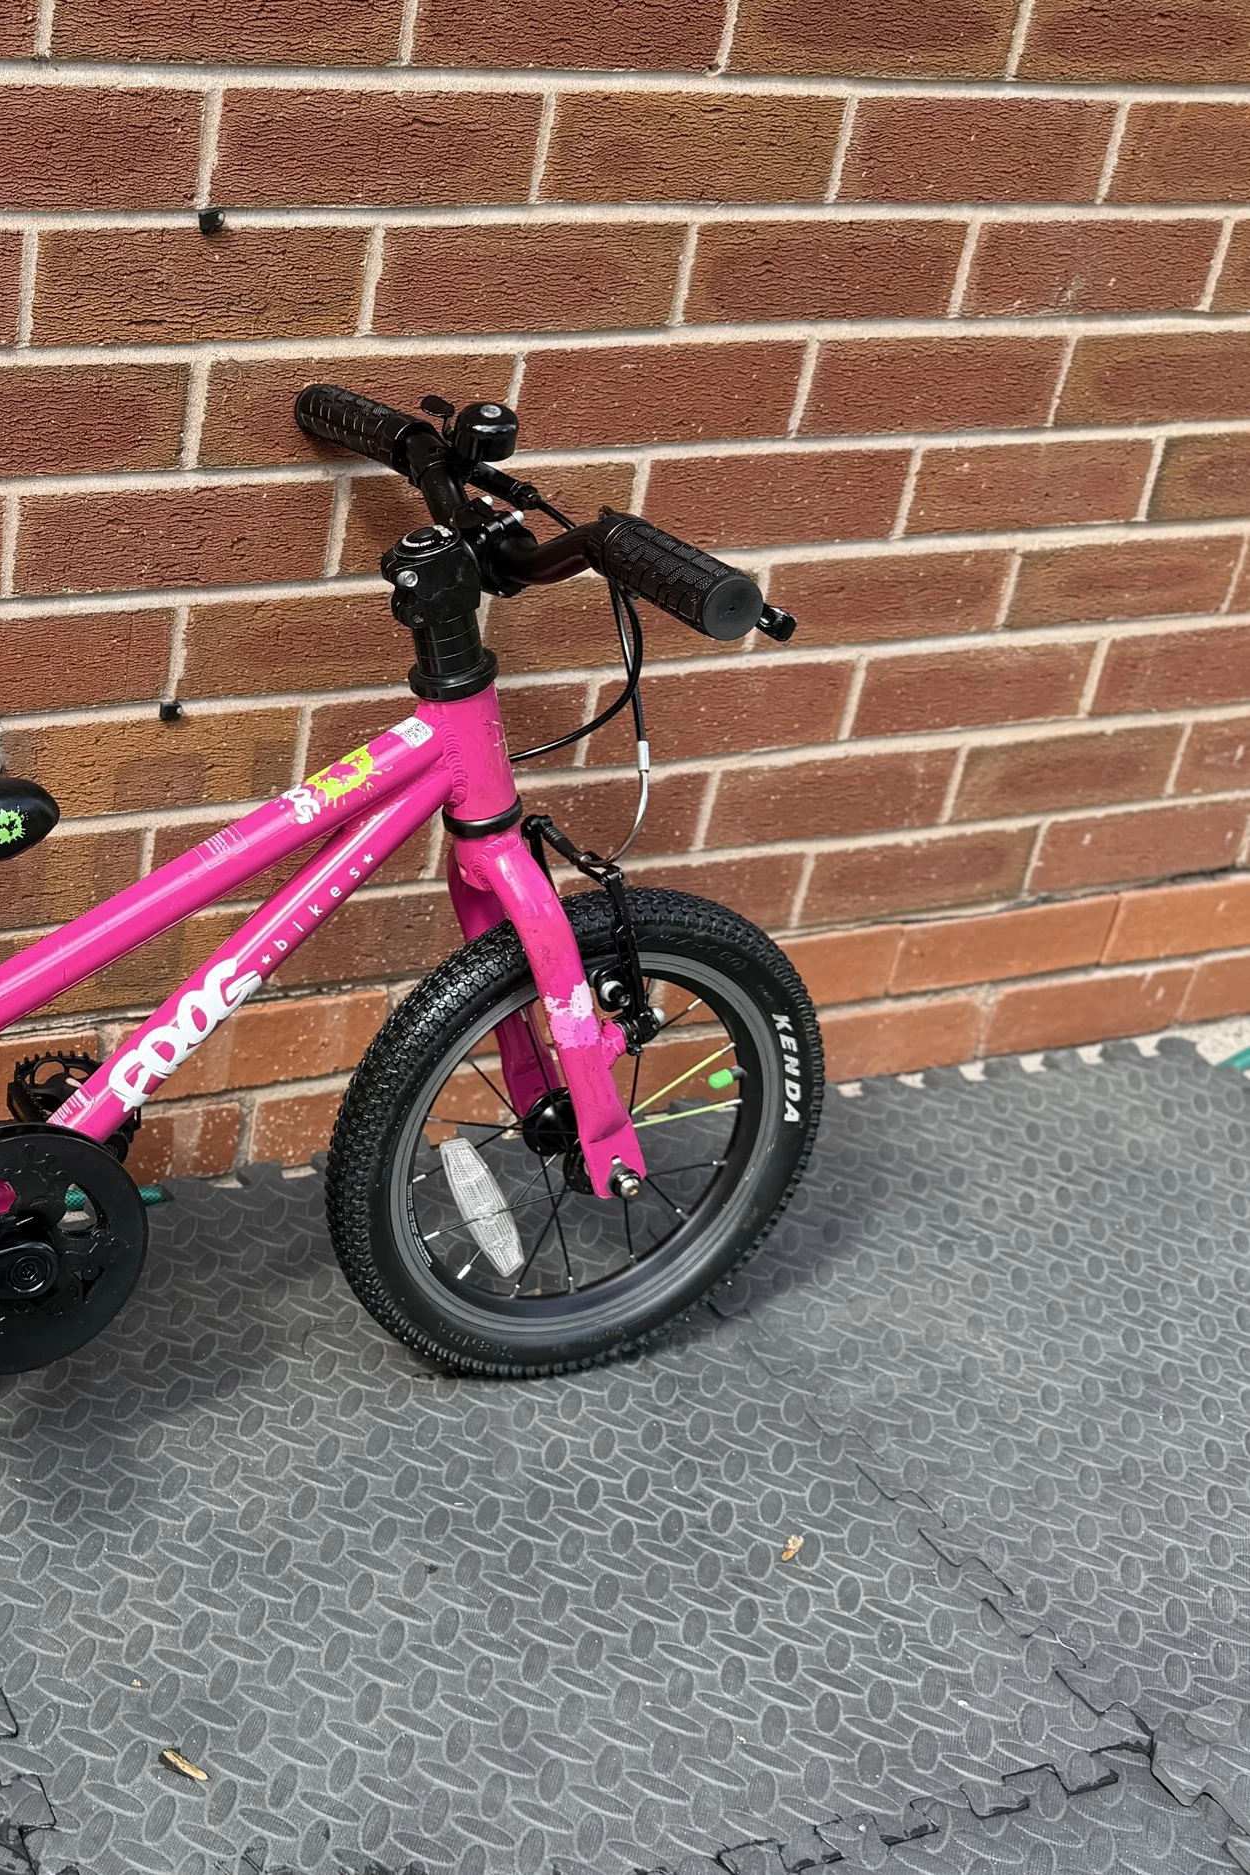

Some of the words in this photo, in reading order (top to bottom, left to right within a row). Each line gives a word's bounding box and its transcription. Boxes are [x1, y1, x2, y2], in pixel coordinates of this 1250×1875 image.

[272, 866, 361, 952] bikes
[108, 957, 263, 1113] FROG
[771, 1013, 802, 1122] KENDA
